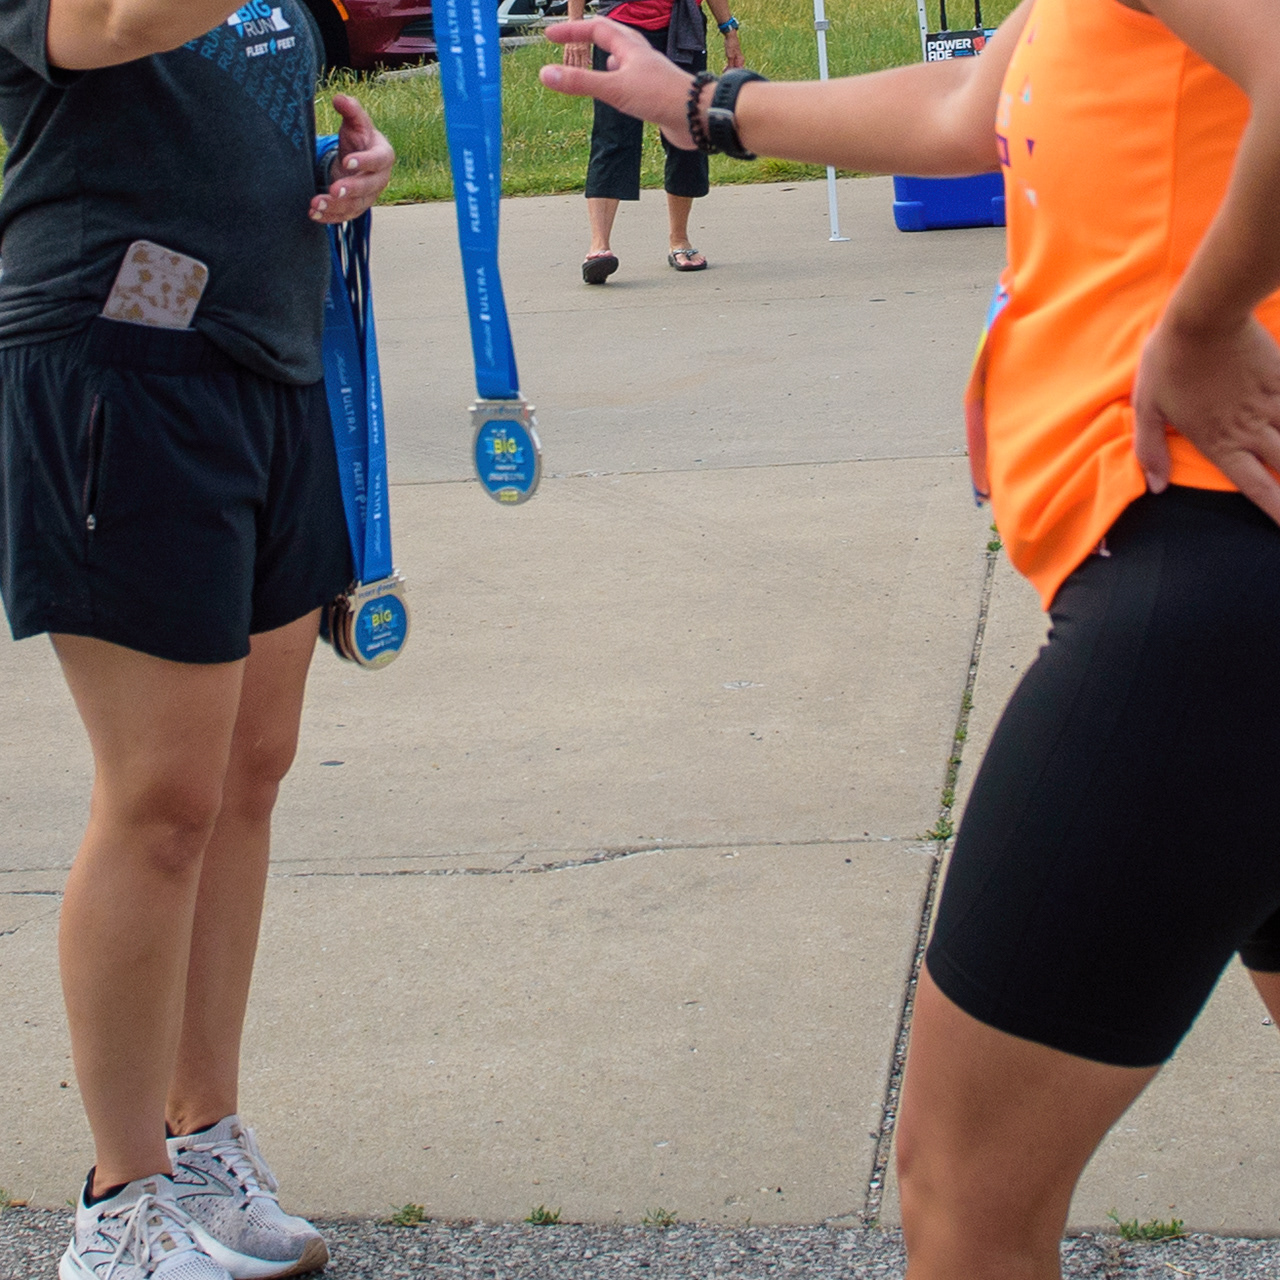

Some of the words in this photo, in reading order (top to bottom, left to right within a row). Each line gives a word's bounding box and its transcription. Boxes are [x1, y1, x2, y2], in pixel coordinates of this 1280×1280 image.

[242, 16, 278, 38] RUN
[245, 42, 269, 58] FLEET
[276, 36, 296, 51] FEET
[927, 38, 972, 52] POWER
[928, 50, 953, 62] ADE
[477, 267, 491, 313] ULTRA
[343, 396, 357, 434] ULTRA
[494, 437, 518, 454] BIG
[372, 609, 393, 628] BIG
